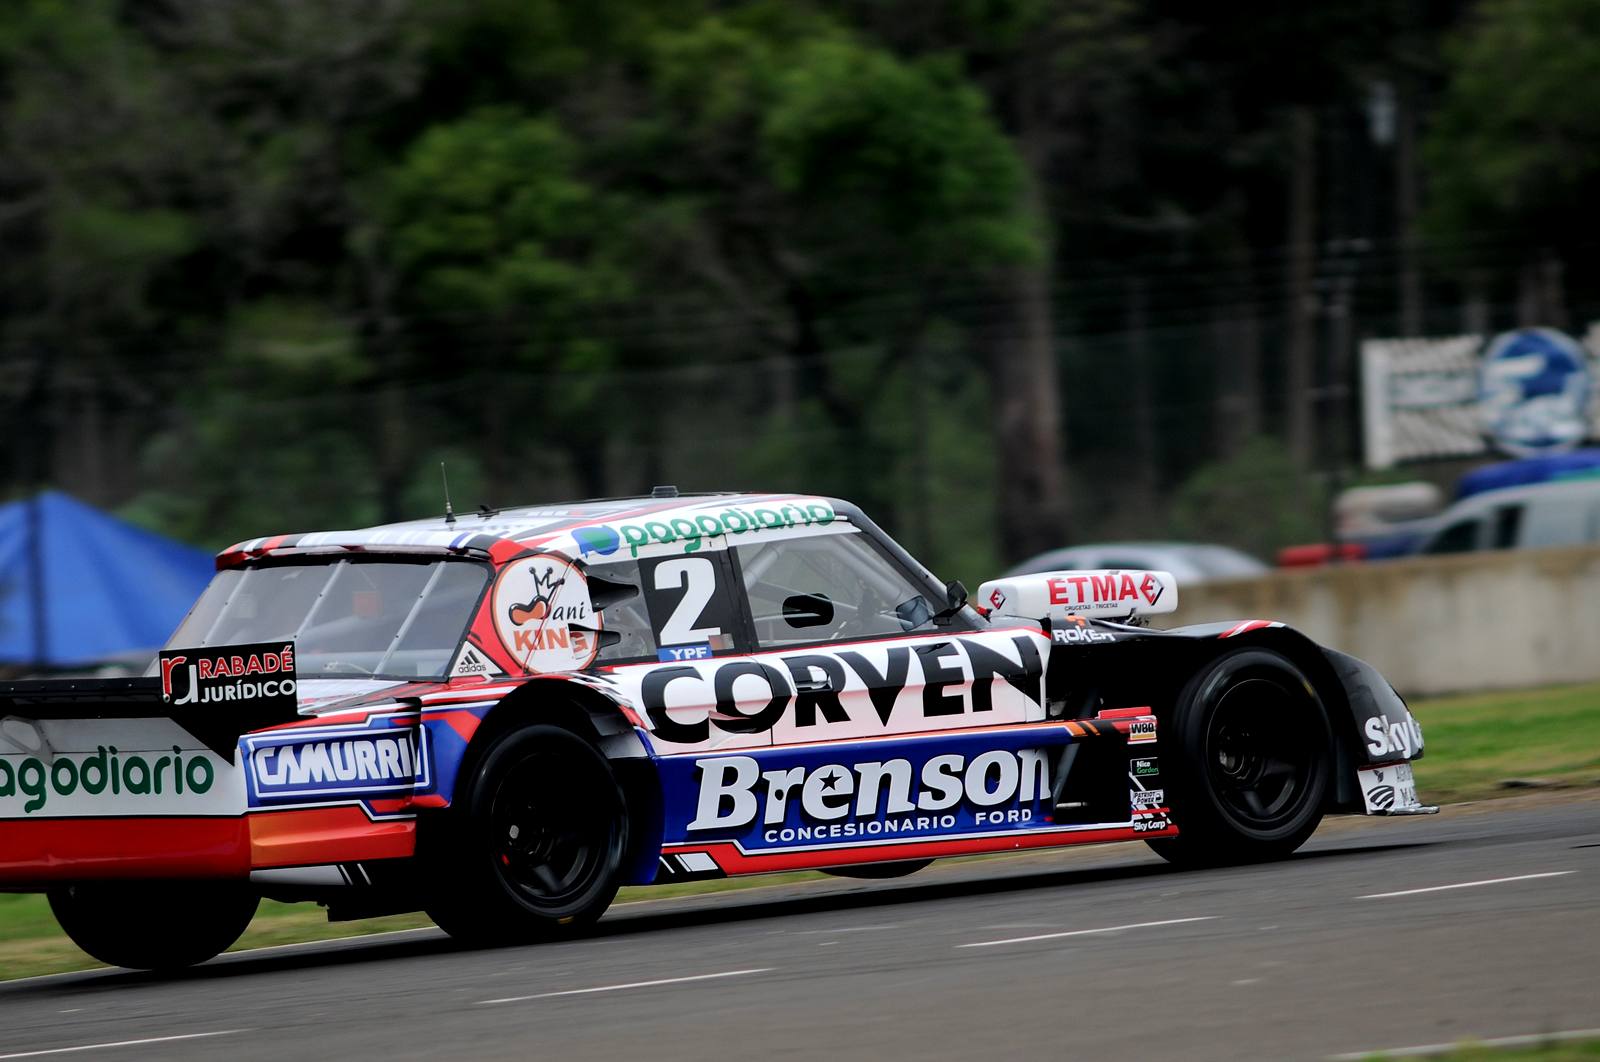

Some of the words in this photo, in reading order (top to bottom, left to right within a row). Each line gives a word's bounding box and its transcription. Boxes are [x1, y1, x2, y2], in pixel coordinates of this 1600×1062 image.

[620, 503, 835, 558] pagodiario
[653, 557, 721, 647] 2
[1047, 575, 1139, 605] ETMA
[1064, 604, 1091, 612] CRUCETAS
[1095, 602, 1119, 610] TRICETAS
[513, 627, 589, 654] KING
[669, 646, 708, 660] YPF
[198, 645, 294, 679] RABADÉ
[458, 664, 487, 674] adidas
[200, 679, 297, 703] JURÍDICO
[641, 636, 1045, 743] CORVEN
[255, 738, 412, 785] CAMURRI
[687, 748, 1051, 831] Brenson
[764, 814, 956, 843] CONCESIONARIO
[975, 808, 1032, 826] FORD
